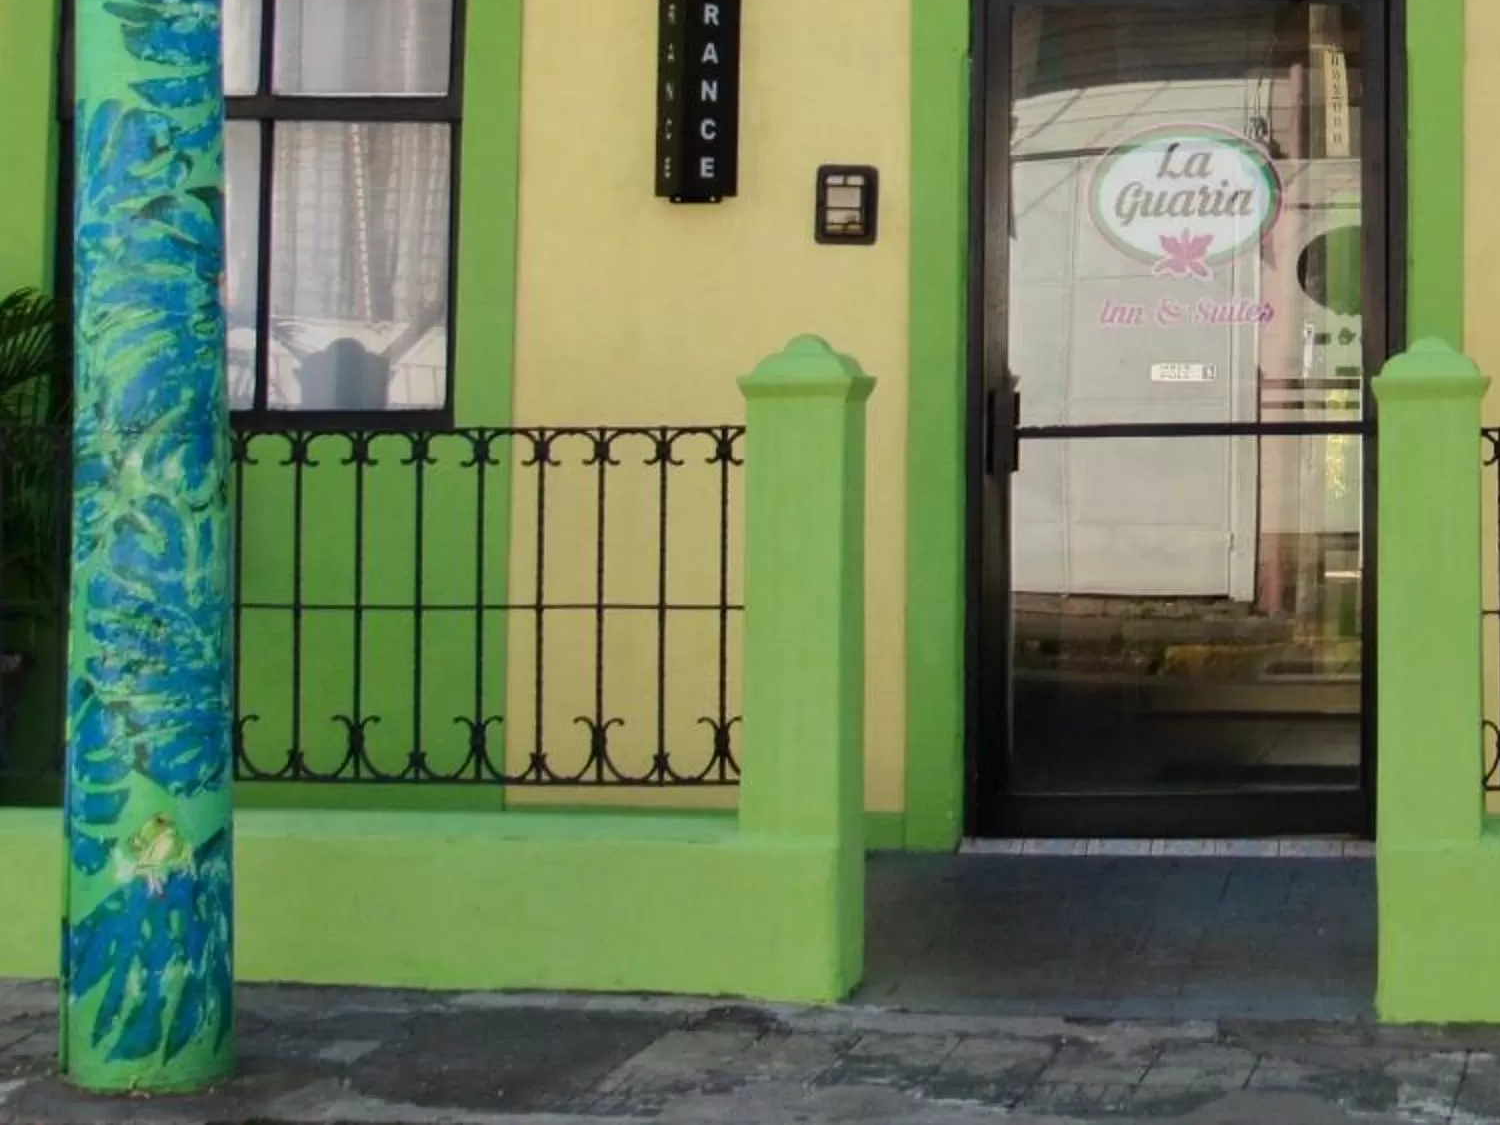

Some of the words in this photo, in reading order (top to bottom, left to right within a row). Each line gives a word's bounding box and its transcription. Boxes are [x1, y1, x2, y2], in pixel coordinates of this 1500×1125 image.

[1155, 141, 1214, 181] La
[1114, 178, 1255, 227] Guaria
[1100, 298, 1145, 328] Inn
[1154, 298, 1187, 327] &
[1193, 296, 1276, 330] Suites
